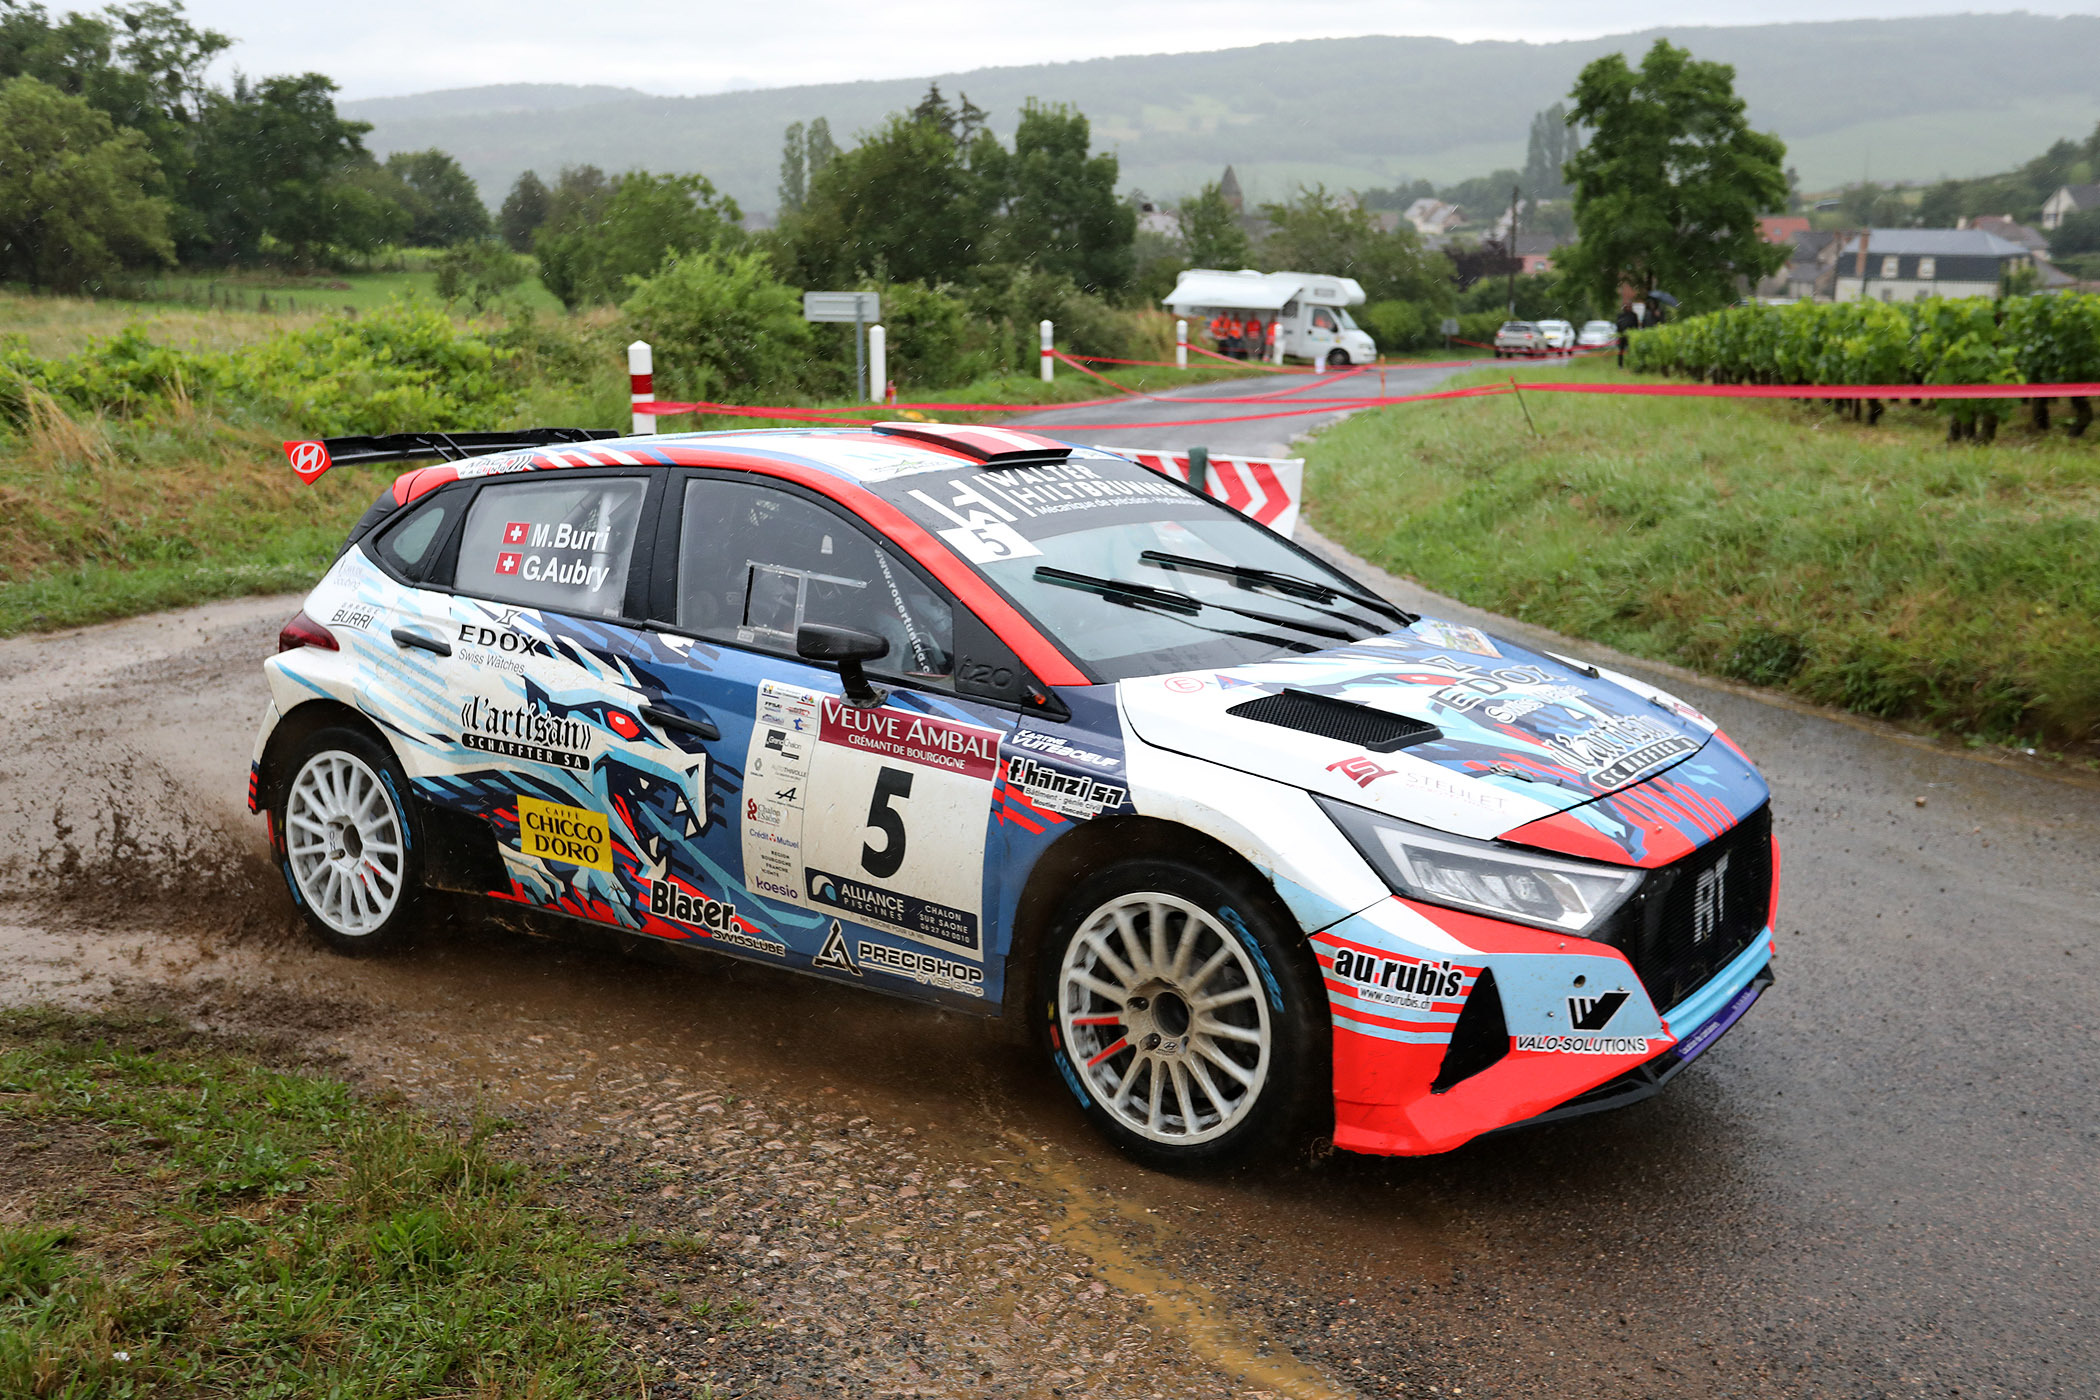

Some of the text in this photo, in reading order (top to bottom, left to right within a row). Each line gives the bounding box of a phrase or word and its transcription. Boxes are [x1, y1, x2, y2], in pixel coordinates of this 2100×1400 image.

[987, 464, 1103, 488] WALTER
[531, 523, 611, 551] M.Burri
[971, 528, 1011, 556] 5
[522, 556, 610, 592] G.Aubry
[331, 609, 375, 630] BURRI
[458, 624, 538, 657] EDOX
[458, 648, 526, 674] Swiss Watches
[1429, 664, 1566, 713] EDOX
[822, 698, 996, 761] VEUVE AMBAL
[1017, 730, 1068, 746] KARTING
[469, 736, 582, 768] SCHAFFTER SA
[847, 733, 966, 770] CRÉMANT DE BOURGOGNE
[1011, 735, 1121, 767] VUITEBOEUF
[758, 803, 781, 816] Chalon
[1025, 787, 1059, 802] Bâtiment
[1085, 802, 1101, 811] civil
[1033, 798, 1057, 810] Moutier
[526, 811, 603, 844] CHICCO
[861, 766, 914, 879] 5
[535, 833, 600, 864] D'ORO
[749, 828, 800, 849] Crédit Mutuel
[755, 875, 798, 899] koesio
[841, 883, 905, 914] ALLIANCE
[844, 897, 904, 922] PISCINES
[924, 905, 963, 922] CHALON
[919, 913, 969, 935] SUR SAONE
[920, 923, 971, 945] 06 27 62 0010
[713, 929, 785, 956] SWISSLUBE
[859, 942, 983, 983] PRECISHOP
[1334, 949, 1463, 997] au rubis
[1360, 987, 1431, 1010] www.aurubis.ch
[1518, 1037, 1647, 1052] VALO-SOLUTIONS
